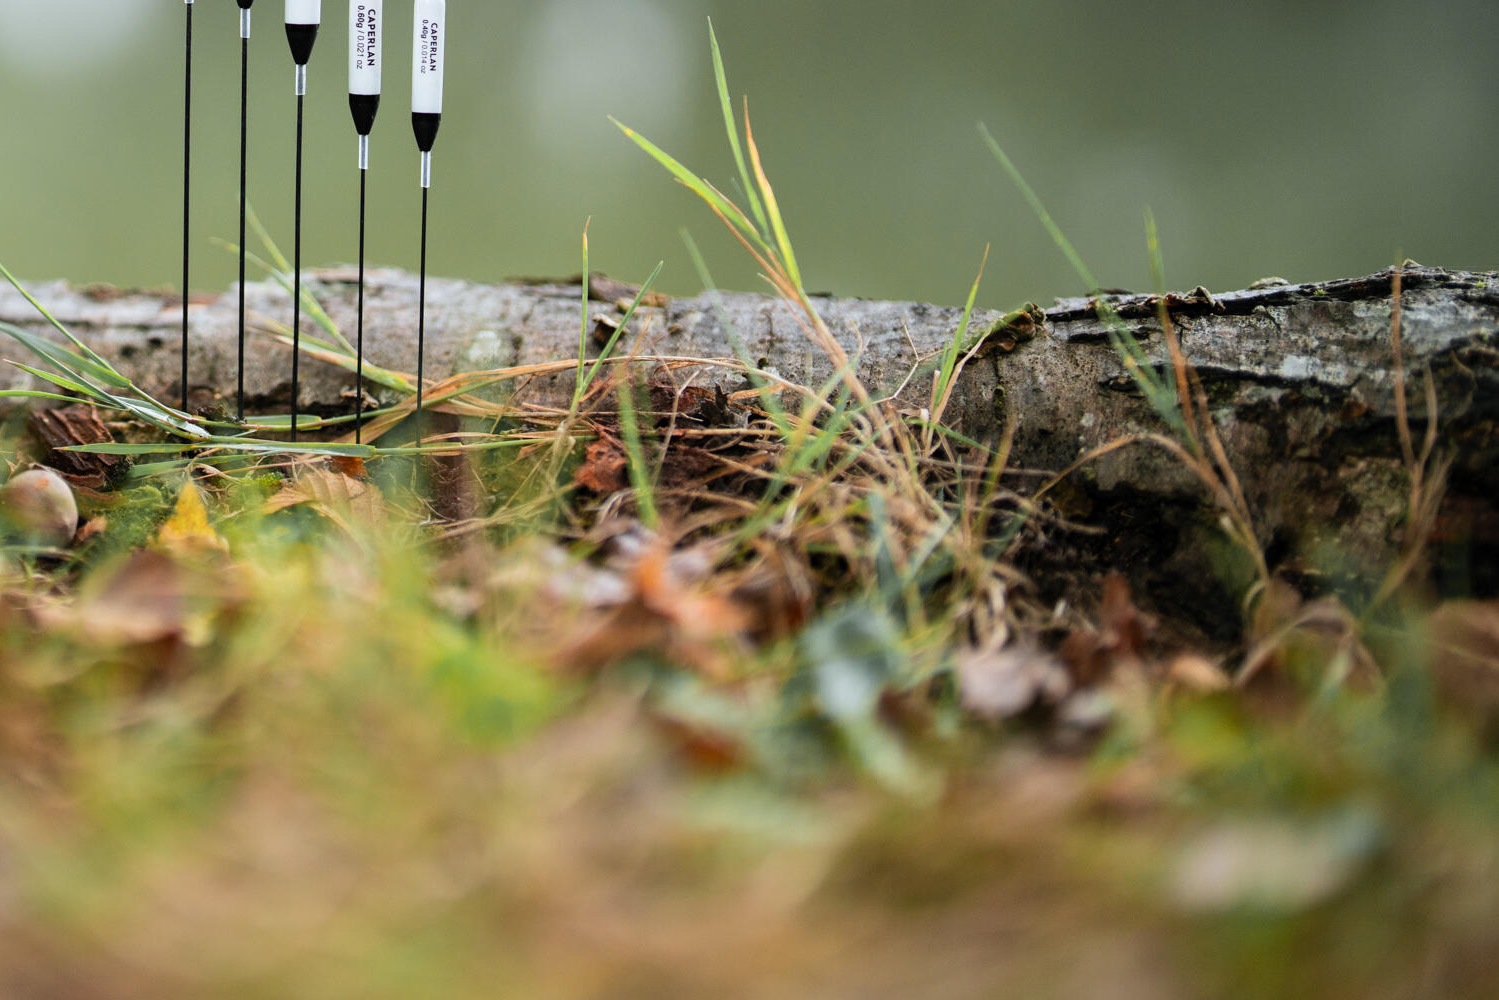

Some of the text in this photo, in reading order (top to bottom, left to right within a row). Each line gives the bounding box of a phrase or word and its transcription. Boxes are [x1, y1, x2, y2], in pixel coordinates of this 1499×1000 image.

[356, 5, 365, 28] 0.60g
[367, 8, 376, 66] CAPERLAN
[421, 19, 429, 39] 0.40g
[429, 22, 438, 72] CAPERLAN
[356, 59, 363, 69] oz
[420, 65, 426, 74] oz
